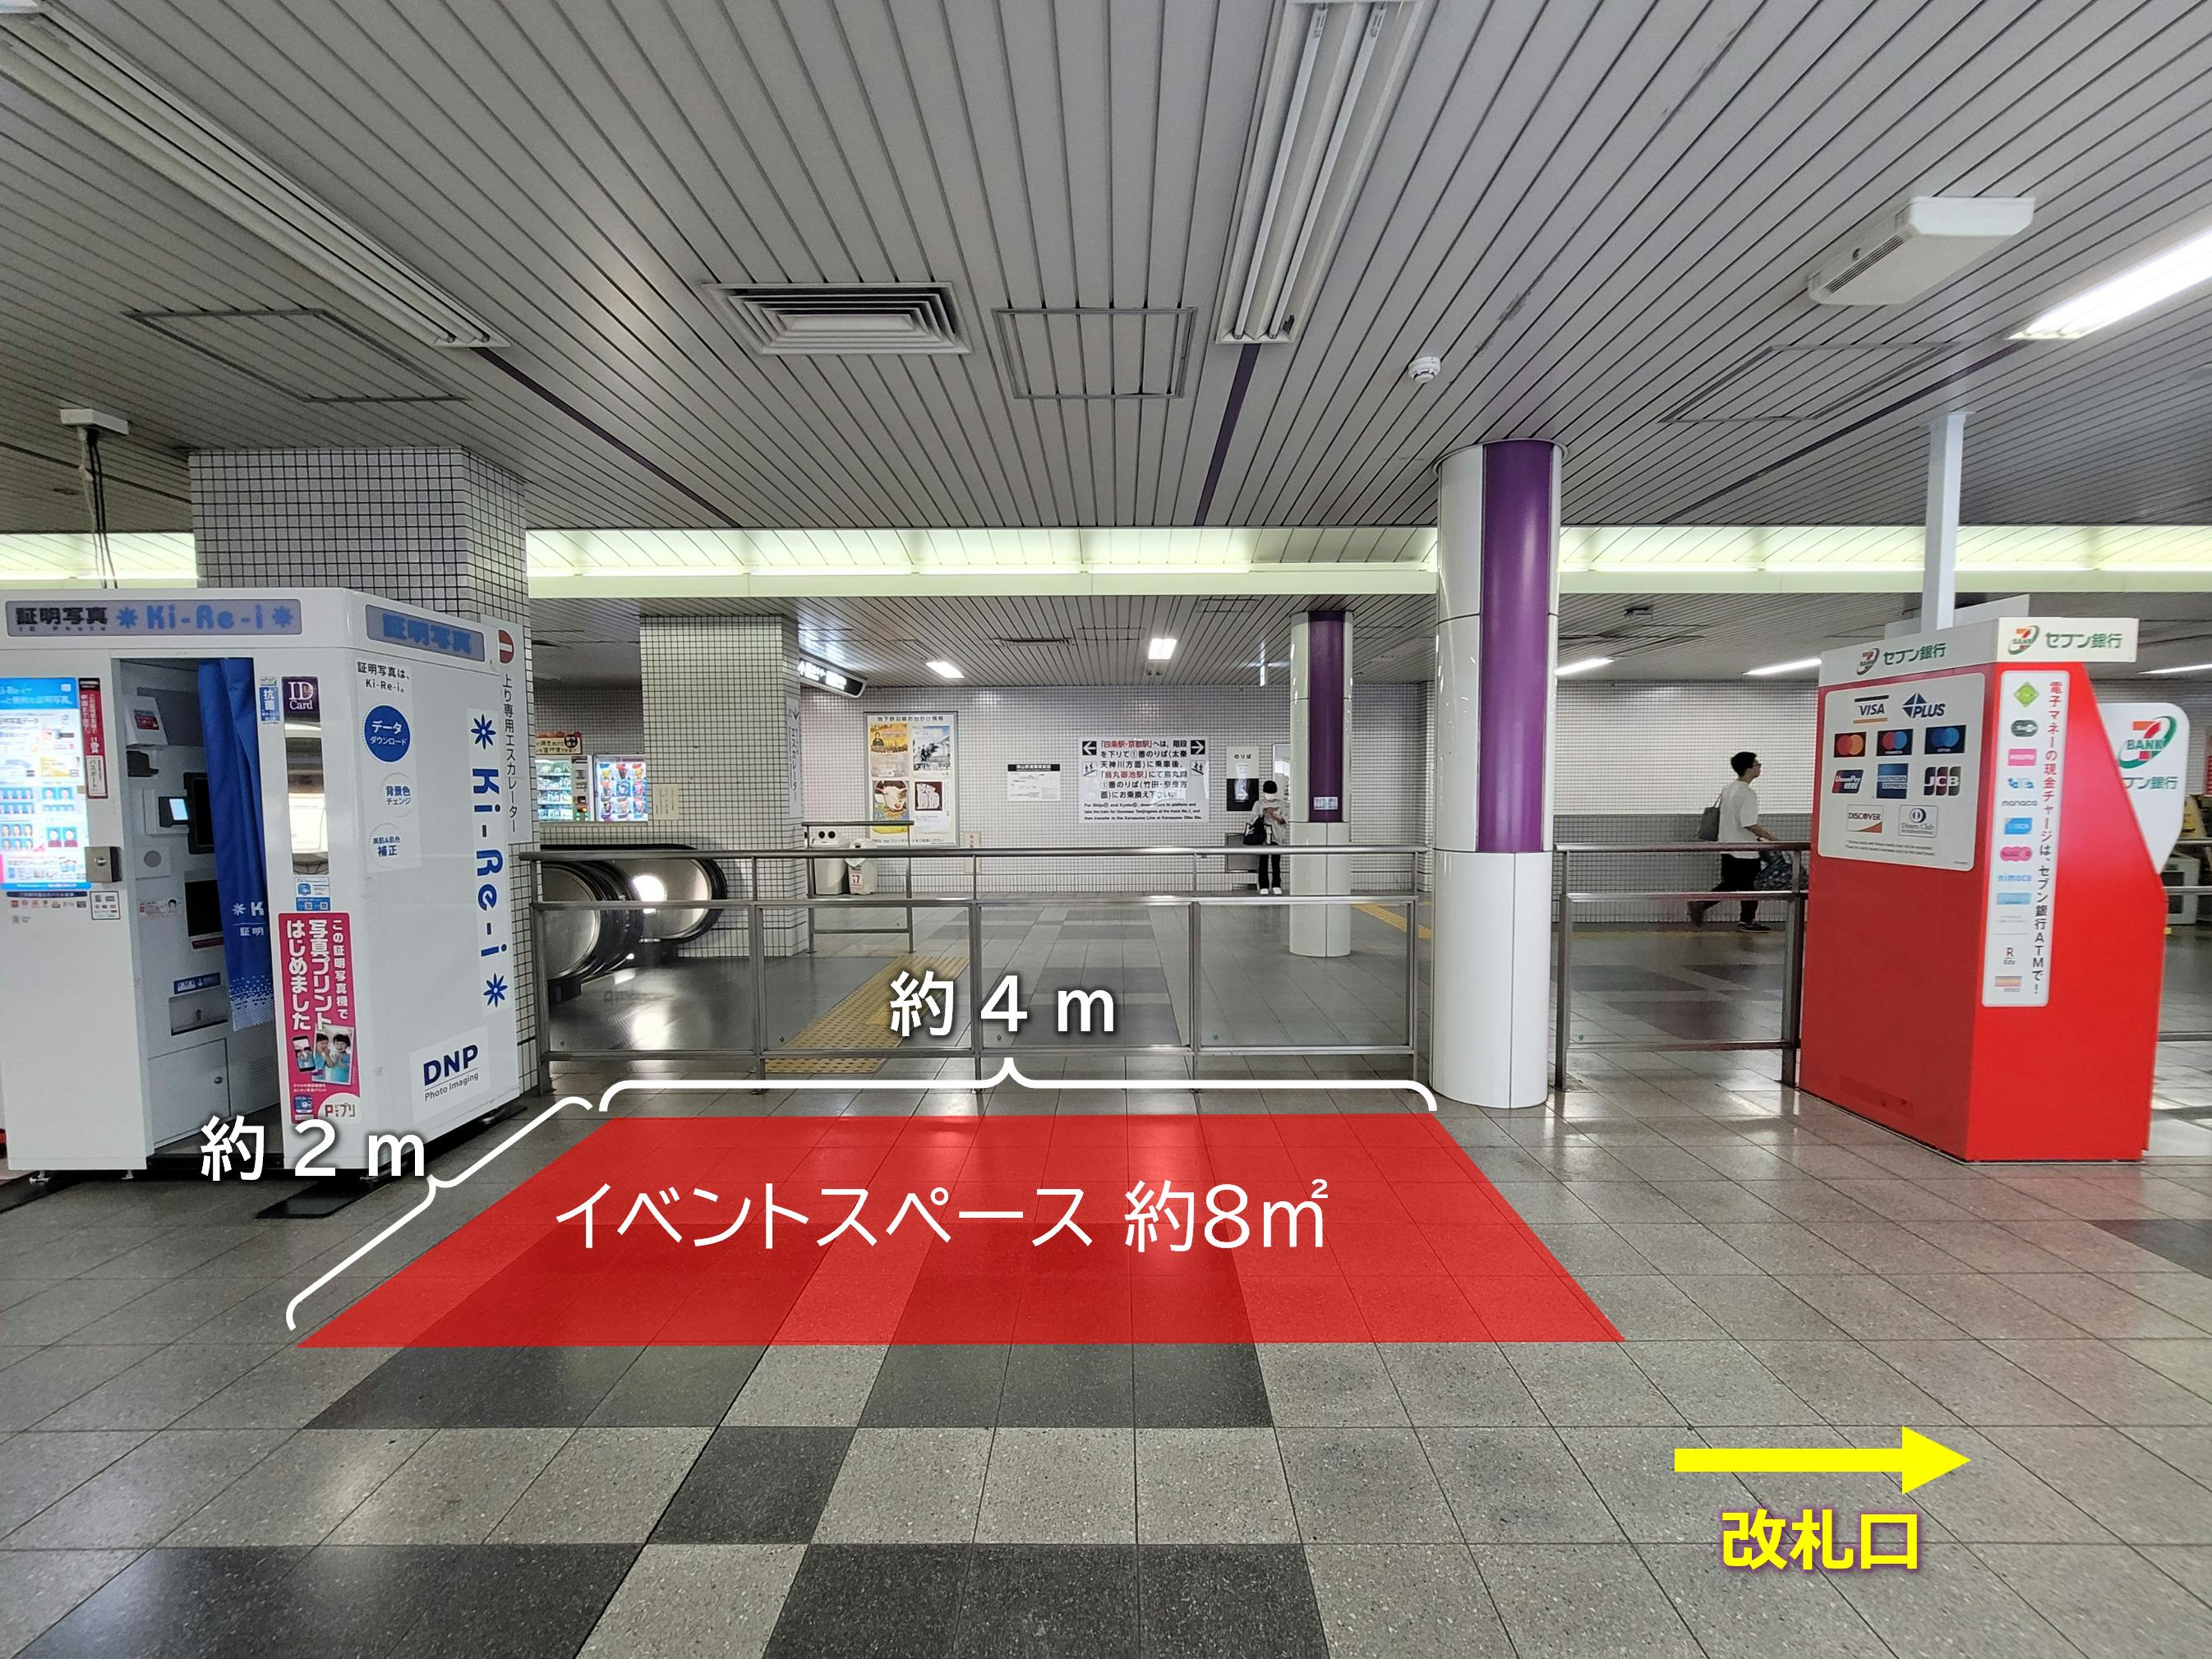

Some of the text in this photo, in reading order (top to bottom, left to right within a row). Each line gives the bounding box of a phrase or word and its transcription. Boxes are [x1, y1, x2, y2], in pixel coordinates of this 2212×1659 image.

[16, 606, 108, 625] 証明写真
[146, 604, 263, 629] Ki-Re-i
[382, 614, 472, 655] 証明写真
[357, 661, 410, 680] 証明写真は、
[288, 682, 314, 700] ID
[289, 700, 313, 710] Card
[1858, 703, 1885, 717] VISA
[1912, 703, 1946, 718] PLUS
[371, 720, 403, 735] データ
[370, 736, 408, 745] ダウンロード
[2127, 740, 2164, 749] BANK
[501, 673, 517, 833] 上り専用エスカレーター
[1924, 777, 1960, 787] JCB
[2122, 777, 2178, 790] ブン銀行
[385, 786, 411, 796] 背景色
[386, 797, 411, 805] チェンジ
[1848, 812, 1881, 821] DISCOVER
[378, 846, 399, 857] 補正
[472, 767, 507, 958] Ki-Re-i
[287, 919, 311, 1030] はじめました
[308, 919, 332, 1030] 写真プリント
[332, 919, 348, 1019] この証明写真機で
[423, 1044, 478, 1086] DNP
[424, 1072, 479, 1101] Photo Imaging
